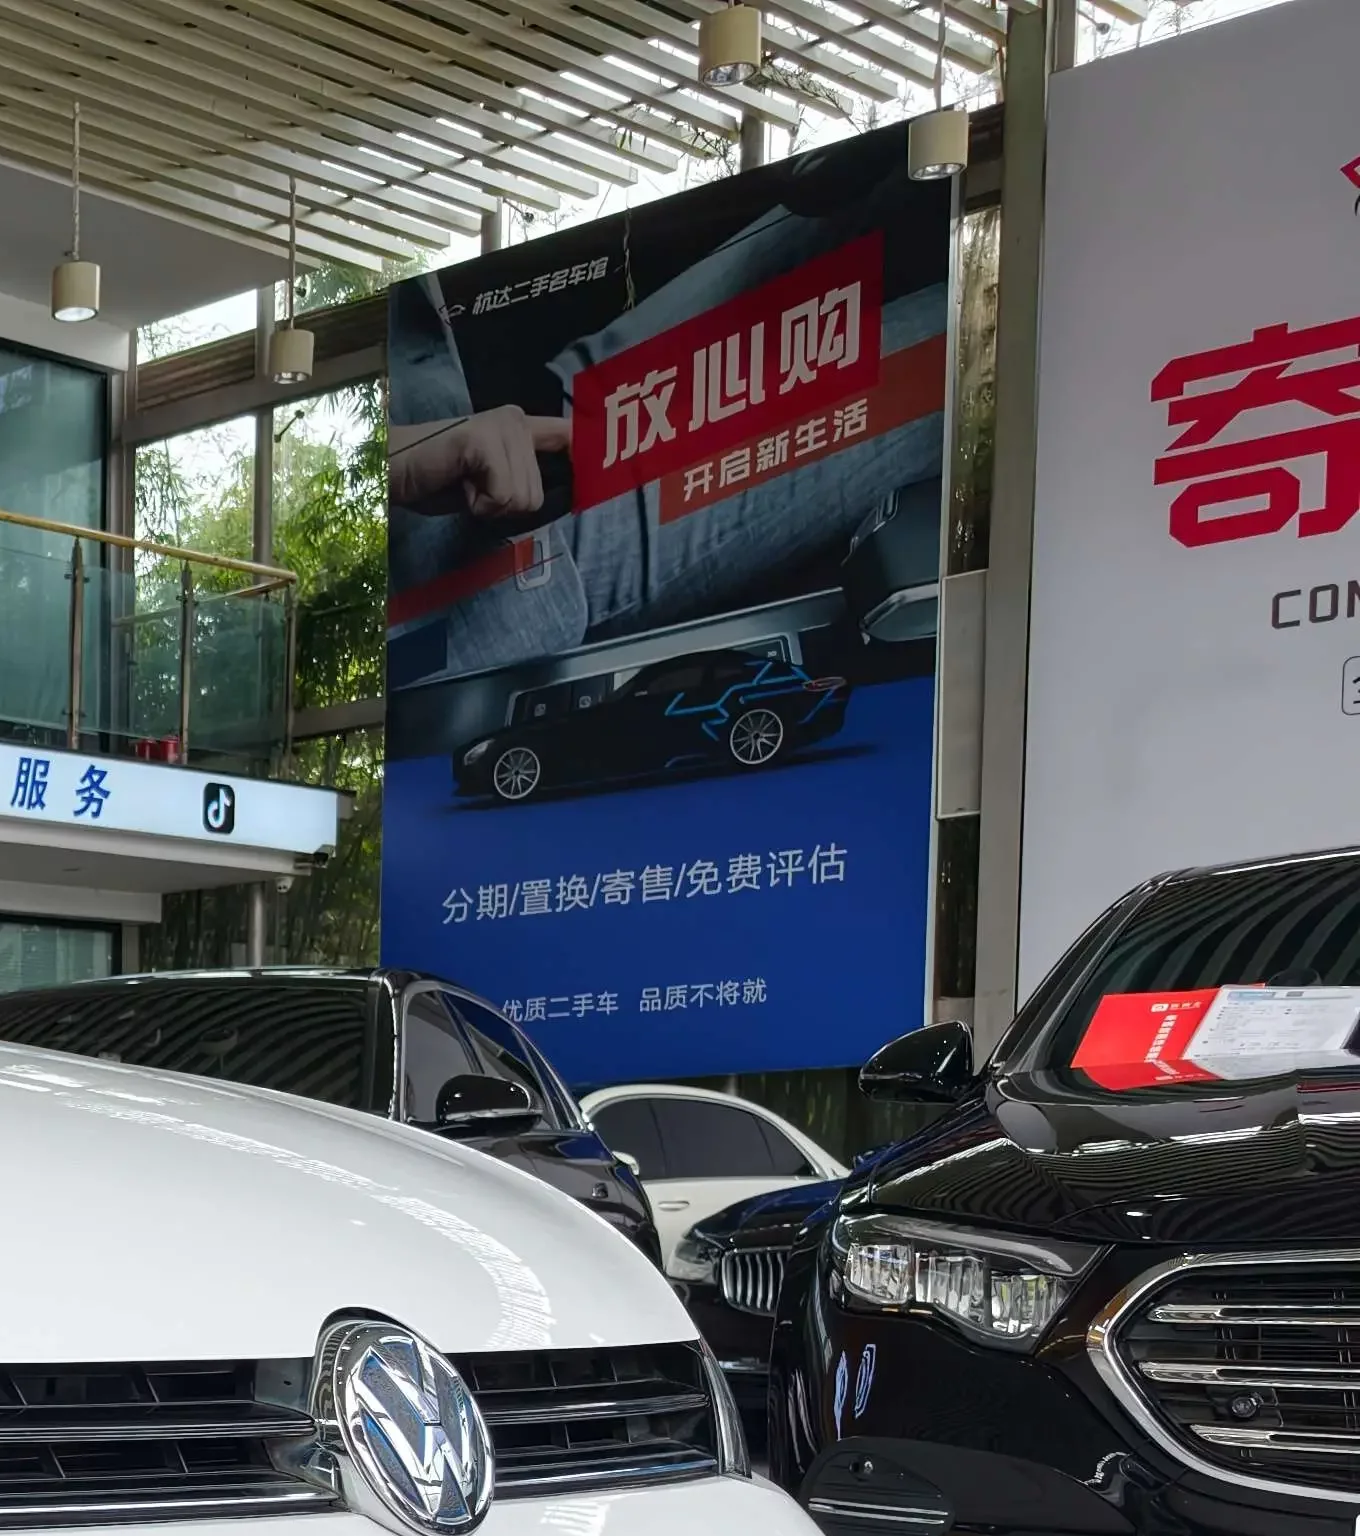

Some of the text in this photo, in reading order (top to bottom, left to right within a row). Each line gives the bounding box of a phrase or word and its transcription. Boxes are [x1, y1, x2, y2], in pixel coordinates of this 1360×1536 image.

[471, 256, 610, 316] 杭达二手名车馆
[602, 280, 863, 469] 放心购
[681, 397, 870, 503] 开启新生活
[440, 841, 848, 926] 分期/置换/寄售/免费评估
[502, 977, 768, 1023] 优质二手车 品质不将就
